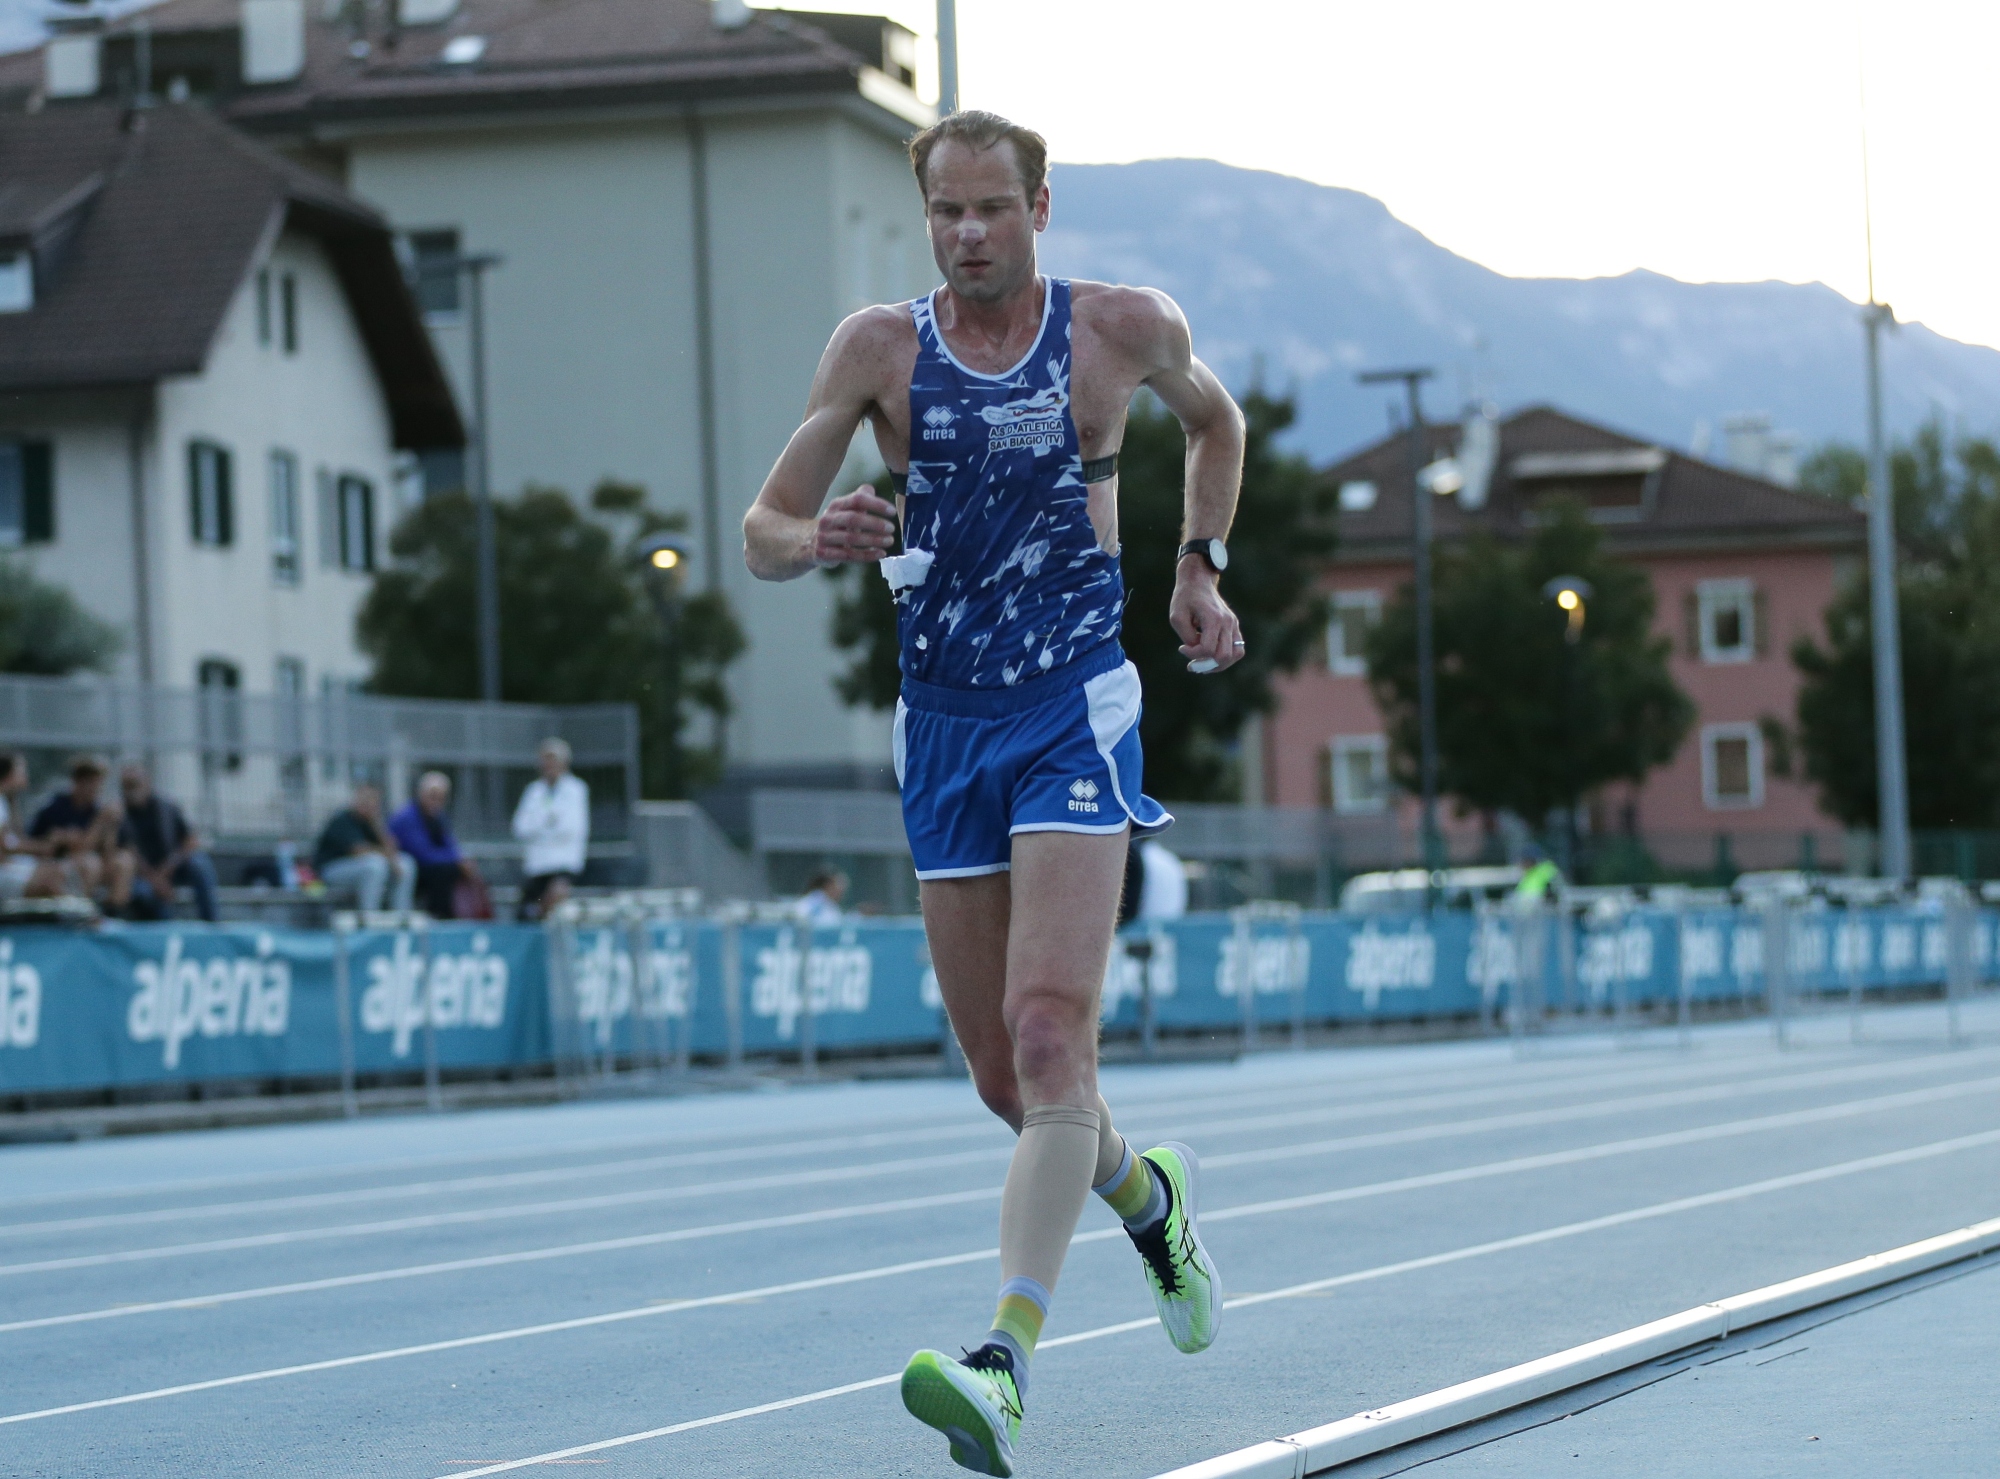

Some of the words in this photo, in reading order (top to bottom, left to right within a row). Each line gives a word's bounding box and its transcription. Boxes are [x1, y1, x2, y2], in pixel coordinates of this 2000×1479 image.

[923, 428, 956, 441] errea
[990, 426, 1015, 437] A.S.D.
[1017, 420, 1063, 433] ATLETICA
[989, 440, 1008, 451] SAN
[1009, 435, 1043, 448] BIAGIO
[1044, 433, 1064, 447] (TV)
[1069, 800, 1098, 812] errea
